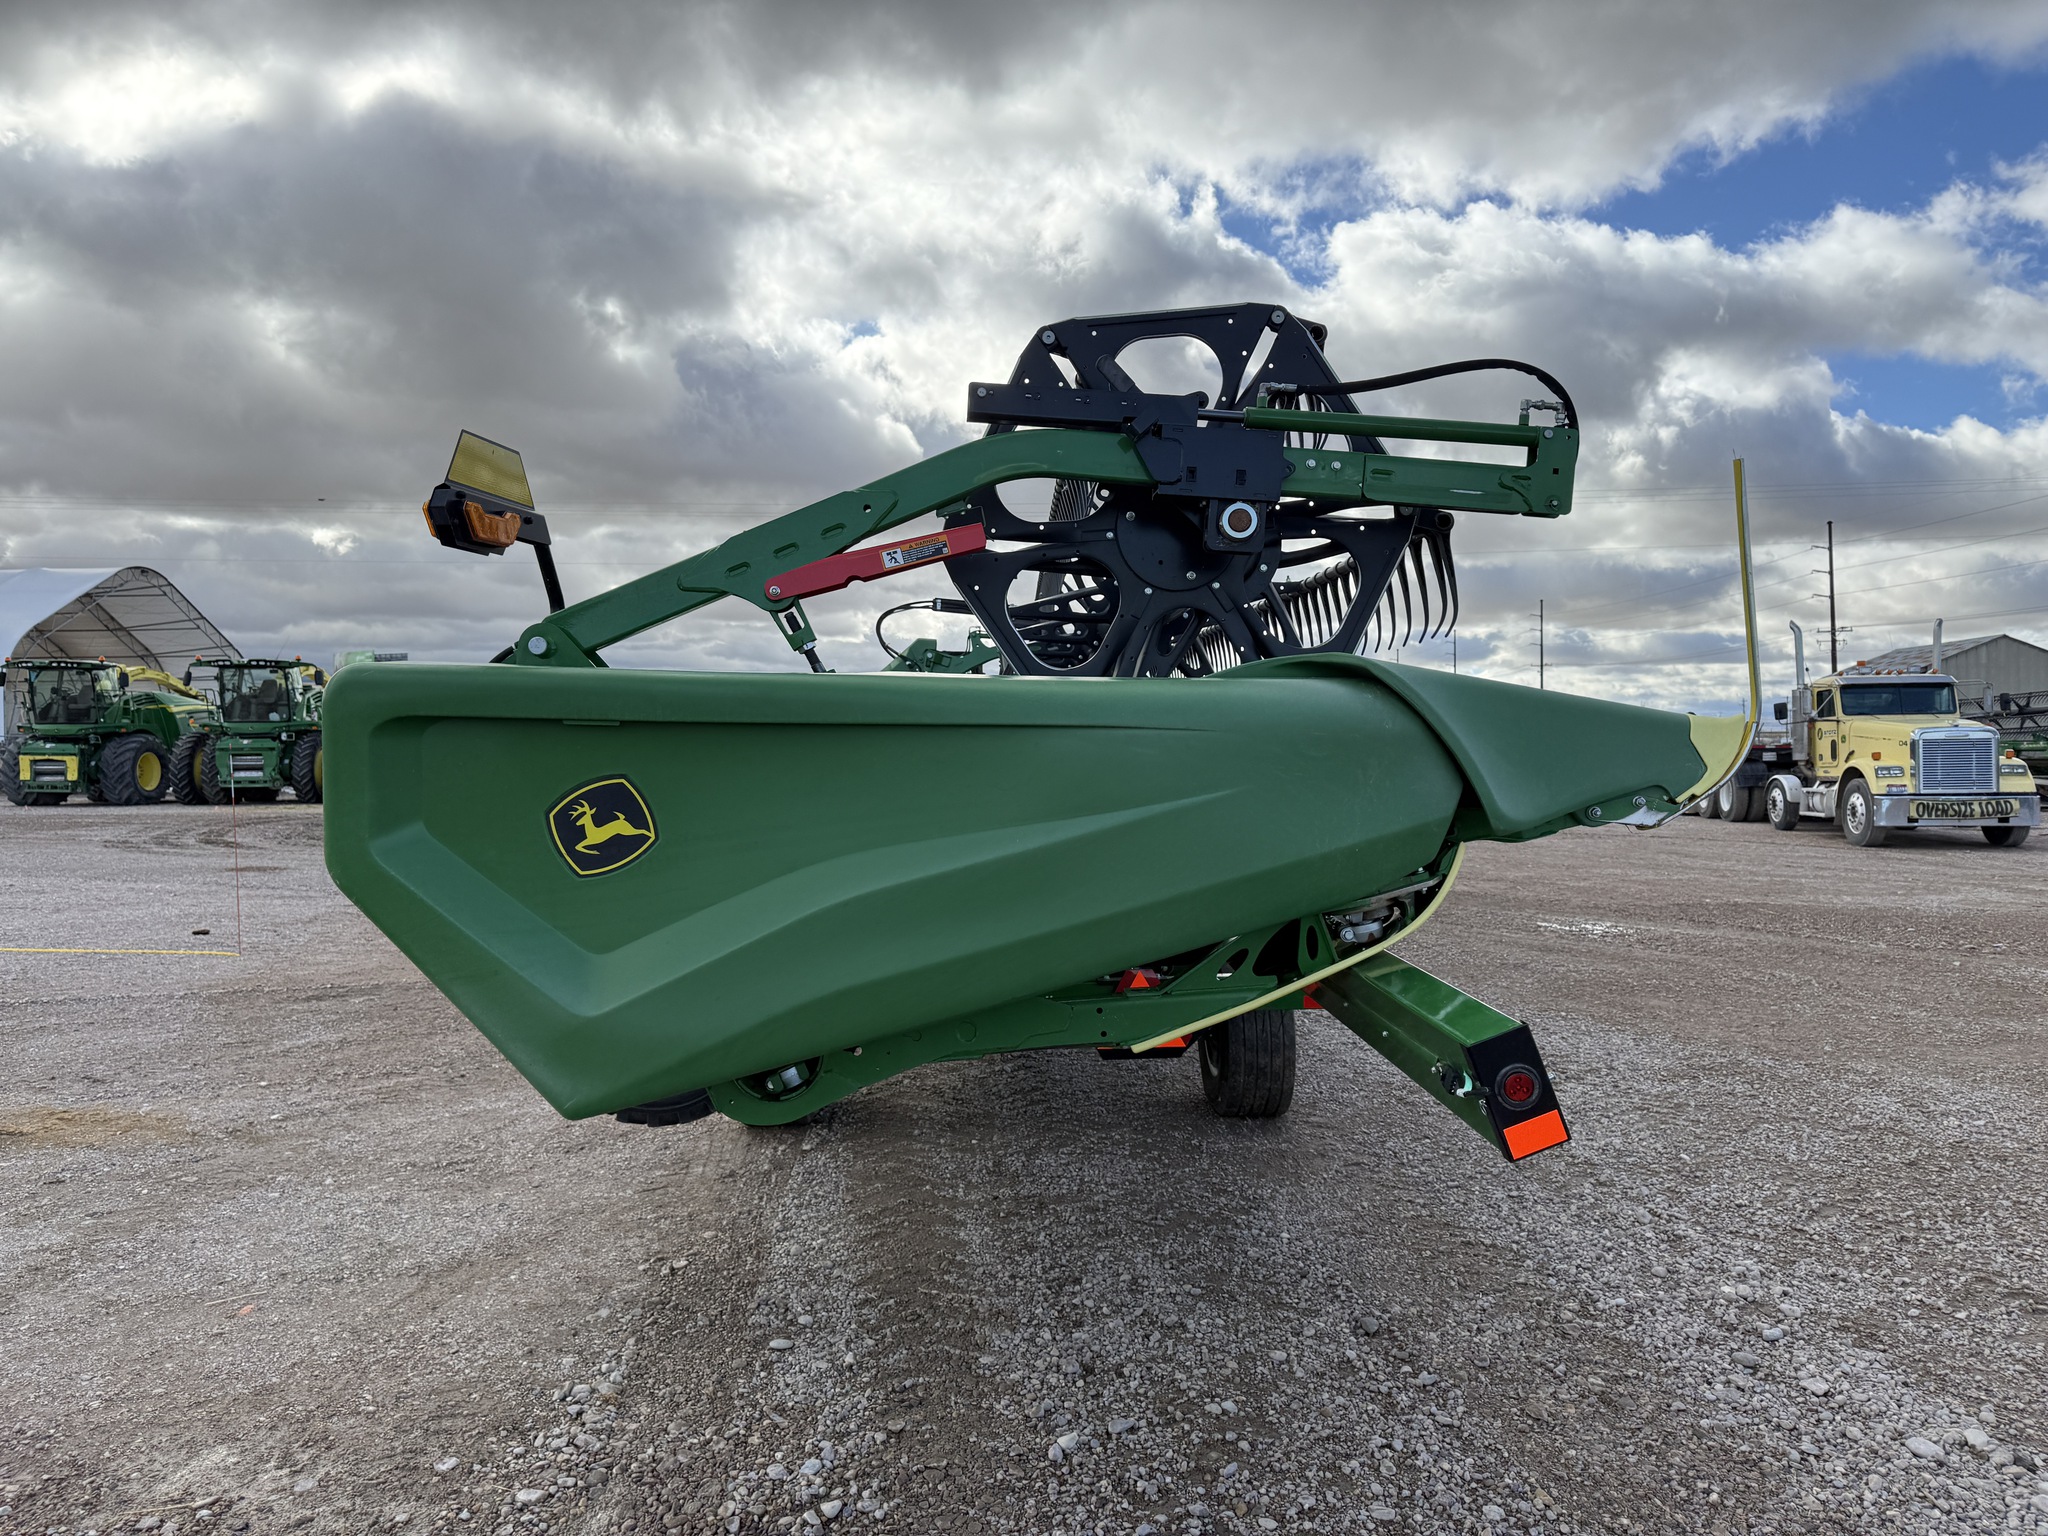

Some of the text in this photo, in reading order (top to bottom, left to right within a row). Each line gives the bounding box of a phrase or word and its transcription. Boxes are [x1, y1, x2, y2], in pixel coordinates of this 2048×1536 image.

[914, 538, 940, 547] WARNING
[1915, 799, 2014, 818] OVERSIZE LOAD
